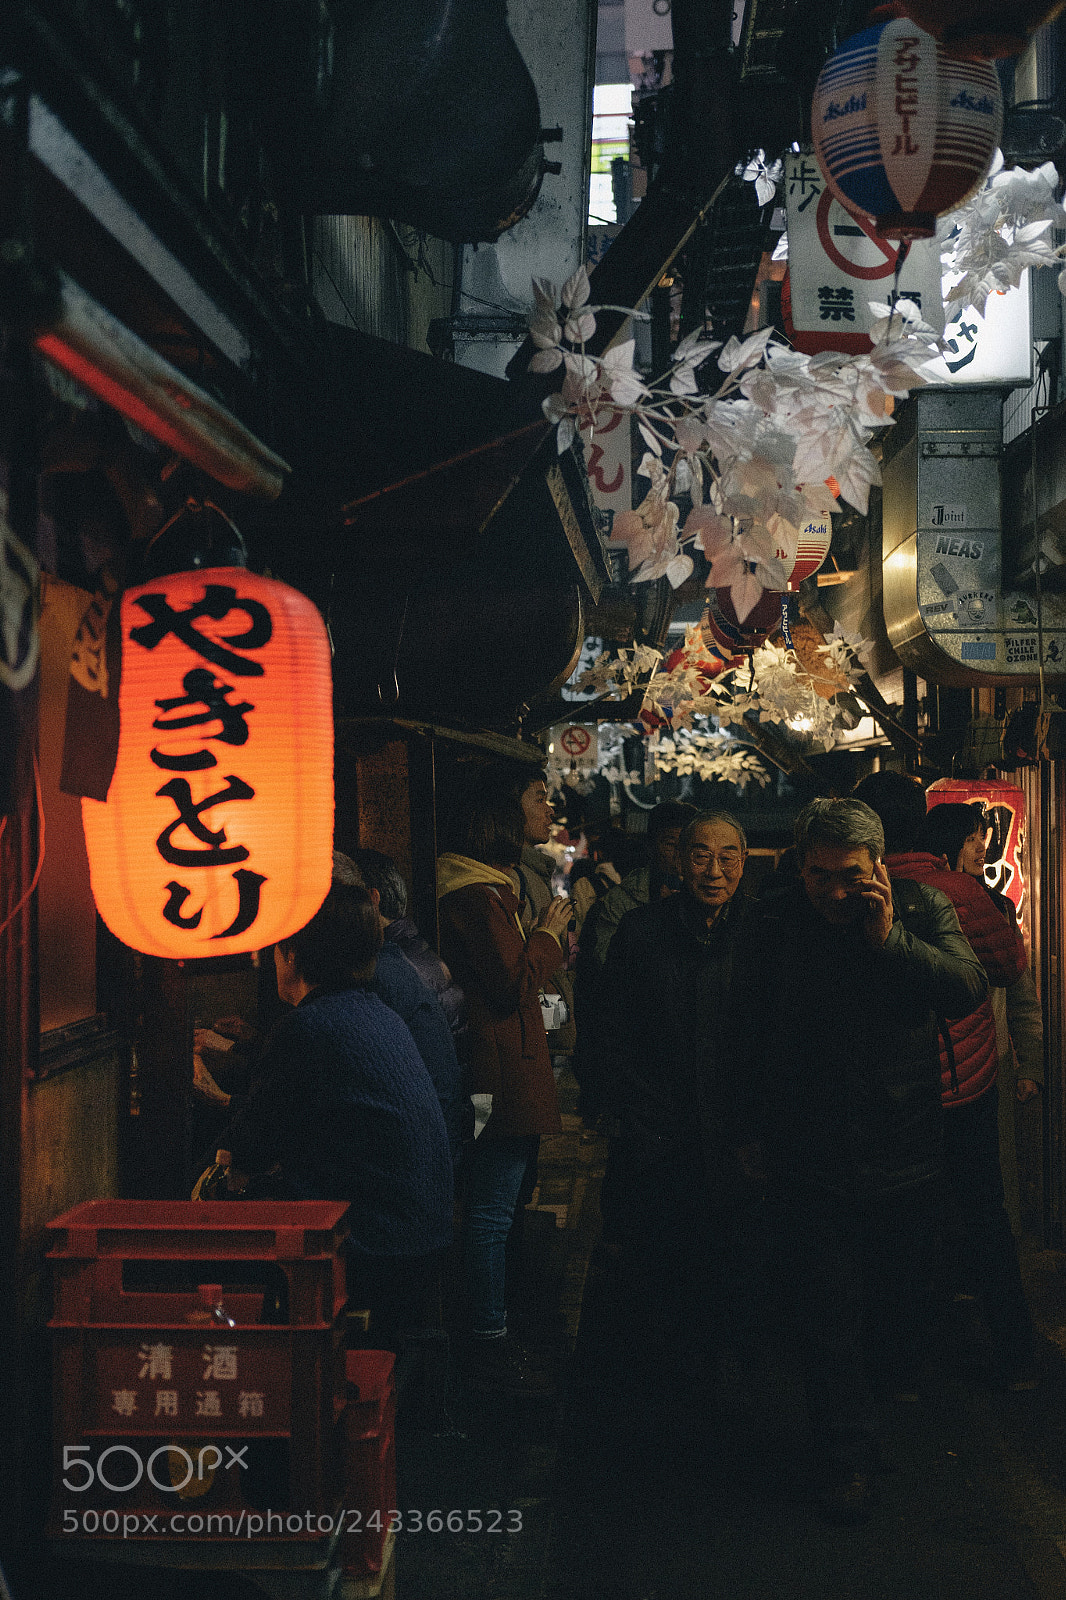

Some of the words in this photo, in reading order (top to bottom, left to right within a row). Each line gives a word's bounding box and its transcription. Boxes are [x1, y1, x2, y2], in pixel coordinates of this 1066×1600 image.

[892, 37, 921, 155] アサヒビール
[823, 92, 867, 122] Asahi
[932, 505, 964, 526] Joint
[804, 523, 827, 534] Asahi
[936, 537, 983, 559] NEAS
[1005, 638, 1037, 648] PILFER
[1008, 647, 1035, 655] CHILE
[1005, 654, 1038, 663] OZONE
[130, 585, 272, 940] やきとり
[138, 1342, 239, 1380] 清酒
